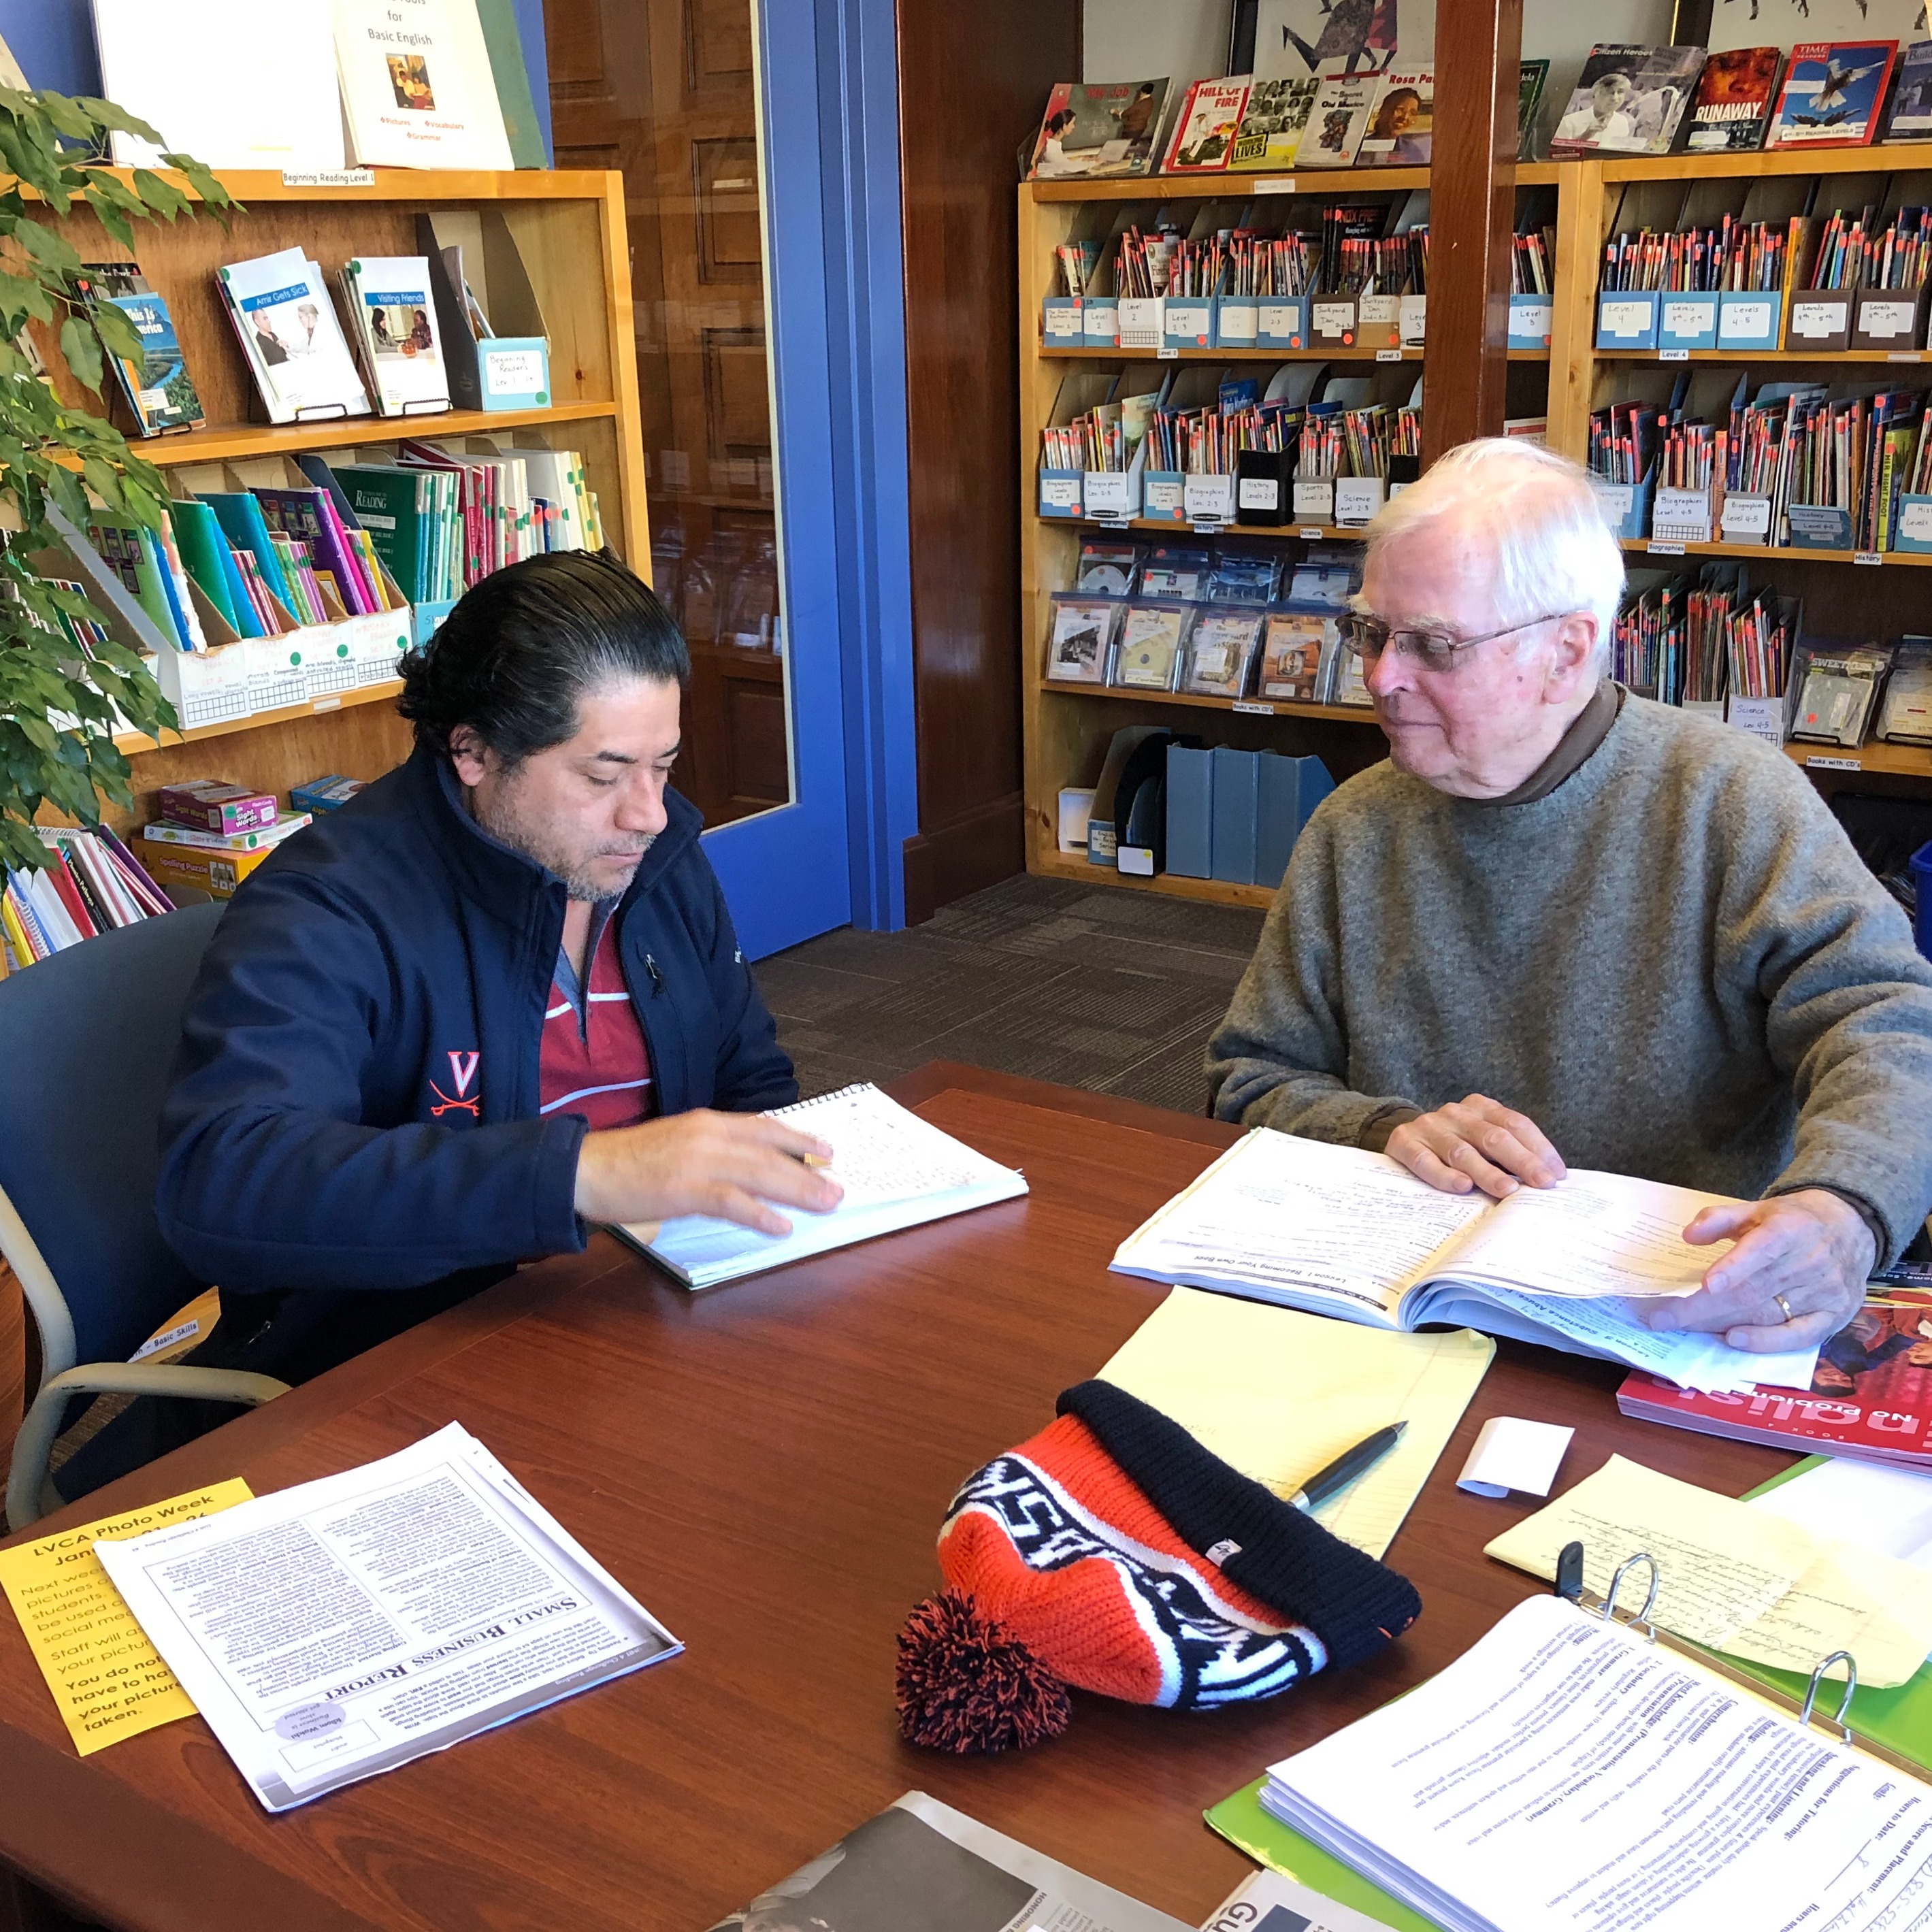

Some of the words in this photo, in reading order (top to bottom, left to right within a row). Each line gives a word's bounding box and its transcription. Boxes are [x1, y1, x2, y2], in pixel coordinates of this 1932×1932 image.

[387, 10, 403, 22] for
[368, 29, 394, 42] Basic
[396, 32, 433, 46] English
[1799, 45, 1830, 54] TIME
[1389, 75, 1415, 84] Rosa
[1214, 97, 1240, 108] FIRE
[1695, 101, 1763, 121] RUNAWAY
[1235, 144, 1263, 159] LIVES
[282, 173, 318, 184] Beginning
[319, 173, 348, 184] Reading
[350, 174, 368, 182] Level
[272, 290, 291, 302] Gets
[291, 285, 308, 297] Sick
[377, 295, 401, 305] Visiting
[401, 294, 425, 304] Friends
[1520, 310, 1542, 318] Level
[1608, 304, 1635, 312] Level
[1733, 306, 1759, 314] Levels
[1172, 313, 1190, 321] Level
[1618, 315, 1624, 323] 4
[1415, 322, 1422, 331] 3
[489, 355, 525, 365] Beginning
[499, 365, 529, 373] Readers
[1883, 455, 1891, 470] HER
[1087, 480, 1121, 489] Biographies
[1246, 480, 1270, 491] History
[1300, 484, 1324, 492] Sports
[1882, 471, 1890, 496] RIGHT
[1188, 487, 1225, 497] Biographies
[1343, 494, 1371, 503] Science
[355, 490, 387, 509] READING
[1660, 496, 1702, 506] Biographies
[1731, 501, 1765, 510] Biographies
[1880, 497, 1888, 519] FOOT
[1726, 514, 1743, 522] Level
[1648, 544, 1685, 553] Biographies
[1854, 554, 1881, 563] History
[1735, 704, 1765, 715] Science
[1807, 757, 1826, 766] Books
[1828, 759, 1844, 767] with
[1846, 760, 1861, 768] CD's
[235, 815, 257, 828] Words
[236, 809, 255, 821] Sight
[159, 856, 186, 871] Spelling
[447, 1051, 480, 1098] V
[1217, 1258, 1236, 1266] Own
[1238, 1260, 1257, 1269] Your
[1259, 1263, 1303, 1277] Becoming
[1313, 1271, 1347, 1284] Lesson
[1548, 1309, 1599, 1335] Substance
[154, 1333, 174, 1347] Basic
[176, 1323, 197, 1337] Skills
[1615, 1338, 1650, 1358] Lesson
[1871, 1410, 1913, 1423] No
[1792, 1427, 1845, 1440] BOOK
[33, 1534, 91, 1557] LVCA
[95, 1514, 153, 1538] Photo
[157, 1495, 215, 1518] Week
[20, 1579, 59, 1597] Next
[26, 1584, 93, 1609] pictures
[31, 1594, 108, 1621] students.
[508, 1597, 577, 1624] SMALL
[37, 1620, 61, 1632] be
[66, 1604, 108, 1622] used
[43, 1622, 93, 1644] social
[50, 1642, 91, 1661] Staff
[95, 1631, 122, 1647] will
[412, 1625, 506, 1667] BUSINESS
[56, 1656, 97, 1675] your
[1597, 1648, 1629, 1677] Grammar
[65, 1674, 100, 1691] You
[105, 1661, 130, 1678] do
[134, 1655, 162, 1670] not
[325, 1664, 409, 1701] REPORT
[1618, 1665, 1657, 1696] Vocabulary
[71, 1684, 118, 1705] have
[122, 1677, 141, 1690] to
[1639, 1677, 1684, 1719] Pronunciation
[78, 1700, 119, 1720] your
[84, 1709, 143, 1733] taken.
[319, 1717, 342, 1729] Idiom
[1687, 1699, 1739, 1746] Comprehension:
[291, 1727, 319, 1739] Watch!
[1822, 1764, 1861, 1798] Suggestions
[1813, 1797, 1827, 1810] for
[1899, 1796, 1922, 1816] Hours
[1784, 1809, 1818, 1841] Tutoring:
[1866, 1854, 1905, 1893] Placement:
[1011, 1892, 1047, 1929] HONORING
